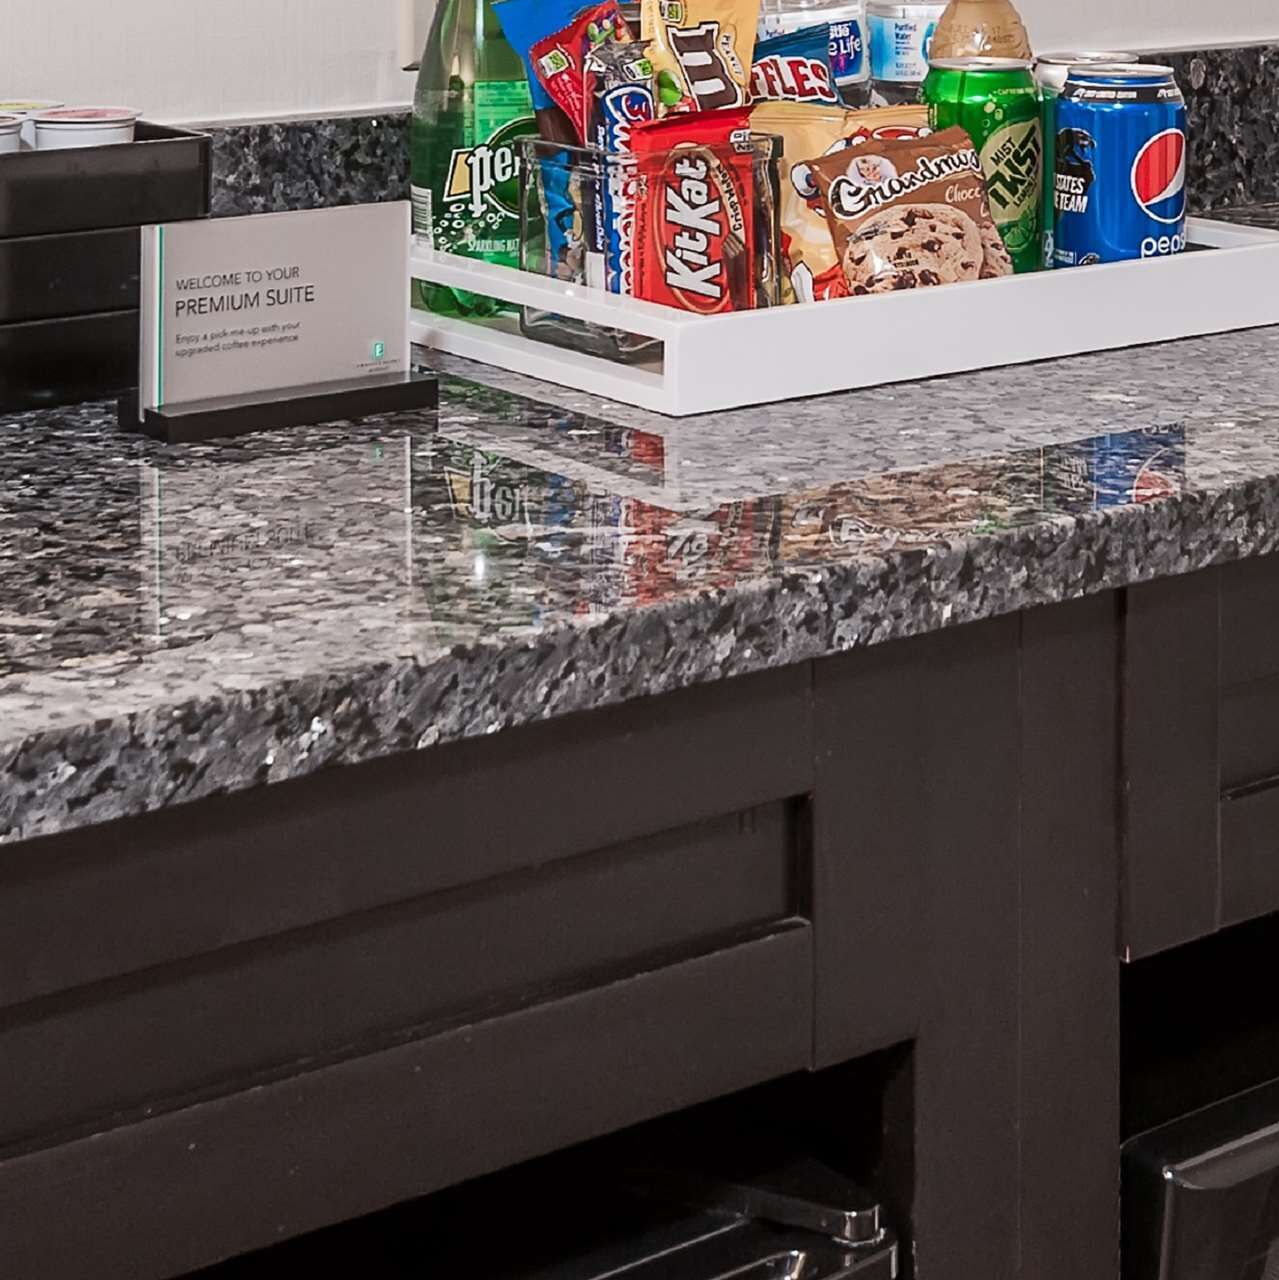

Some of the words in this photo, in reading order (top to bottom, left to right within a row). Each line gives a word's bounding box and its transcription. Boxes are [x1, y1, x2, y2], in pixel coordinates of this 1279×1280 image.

[840, 34, 862, 60] Life
[750, 56, 837, 102] FFLES
[989, 135, 1017, 167] MIST
[724, 198, 743, 232] Crisp
[1060, 193, 1089, 213] TEAM
[176, 271, 241, 291] WELCOME
[245, 270, 262, 283] TO
[265, 266, 300, 281] YOUR
[175, 291, 260, 318] PREMIUM
[266, 285, 315, 306] SUITE
[175, 343, 220, 358] upgraded
[222, 340, 249, 351] coffee
[251, 334, 299, 348] experience
[176, 333, 200, 345] Enjoy
[261, 323, 279, 333] with
[281, 321, 300, 333] your
